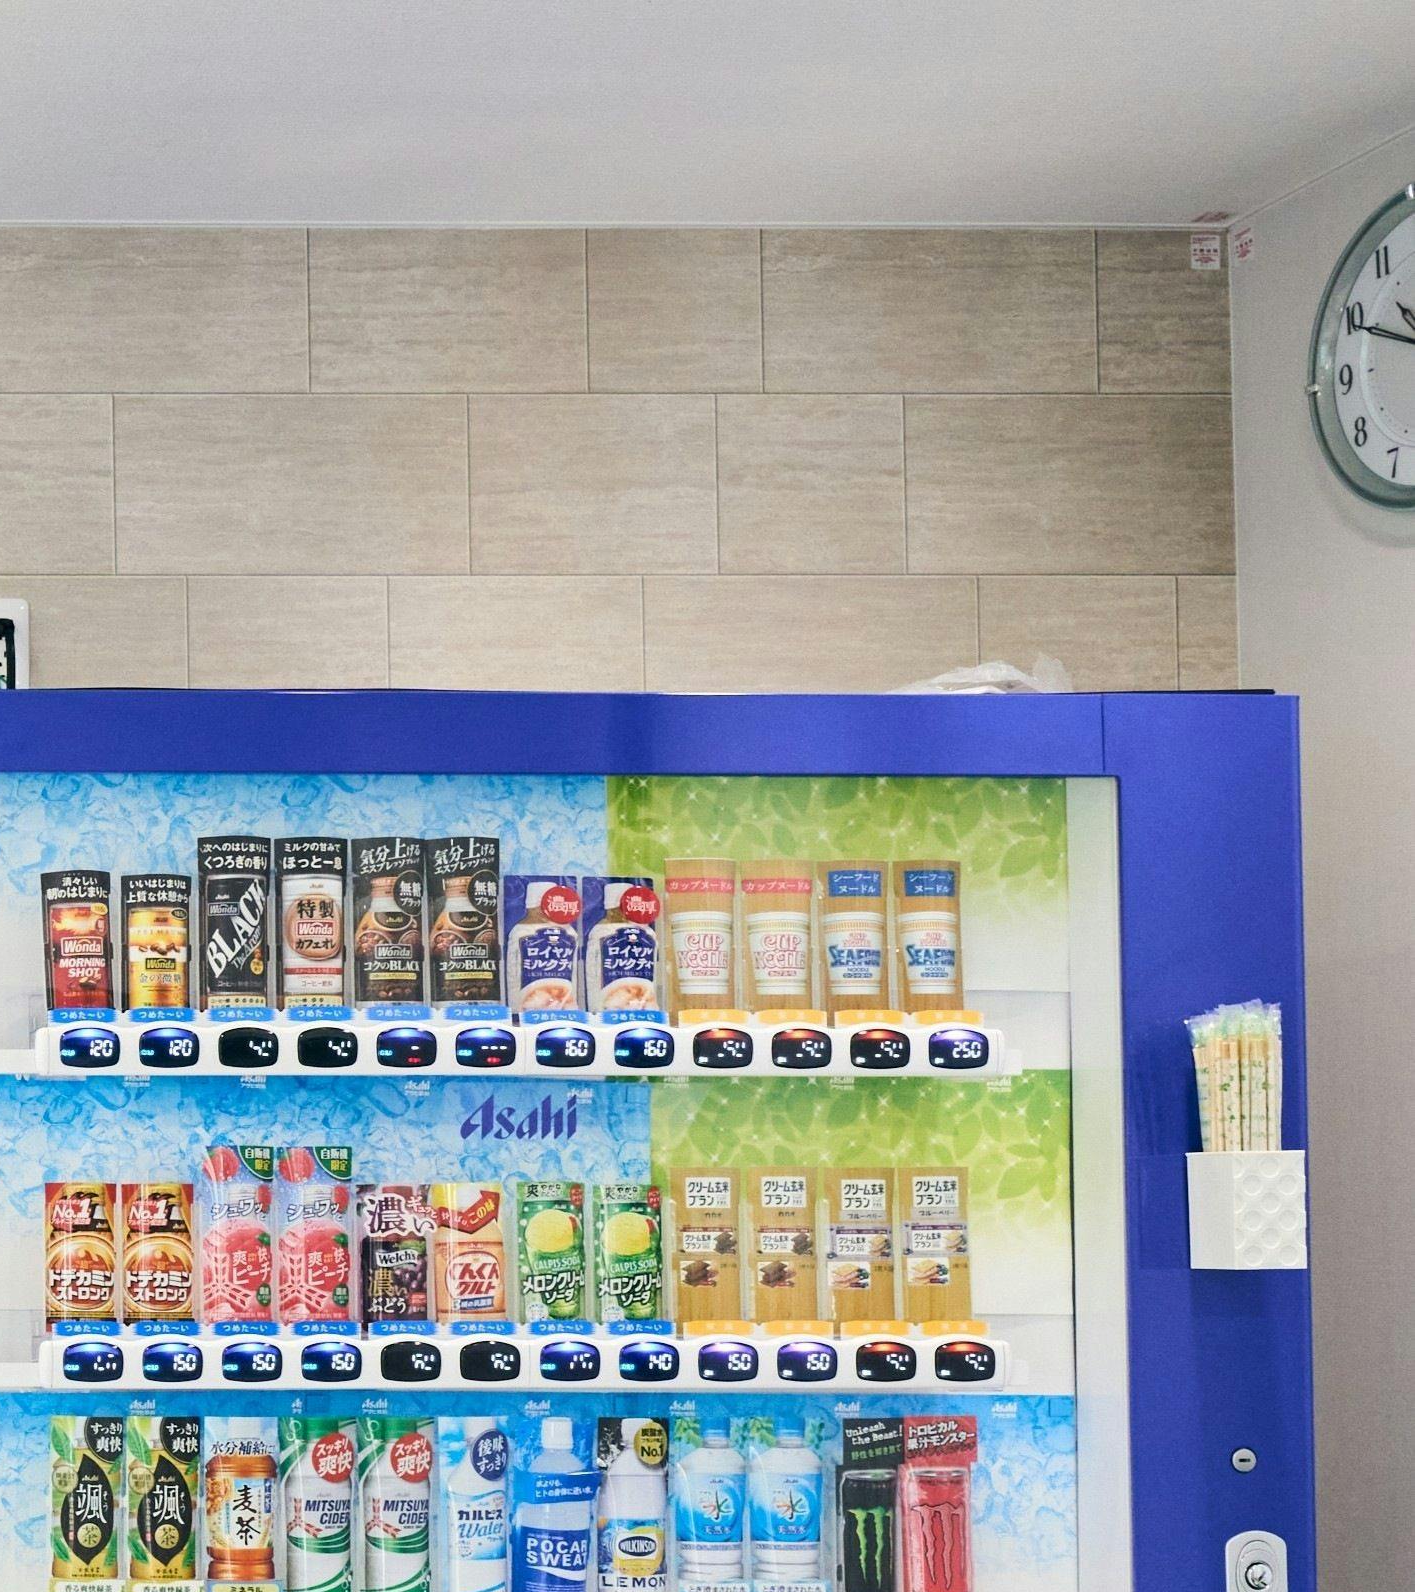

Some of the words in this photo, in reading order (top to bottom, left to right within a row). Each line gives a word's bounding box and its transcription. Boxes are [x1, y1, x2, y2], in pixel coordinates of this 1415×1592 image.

[1376, 246, 1389, 278] 11
[1347, 302, 1363, 334] 10
[1340, 365, 1352, 394] 9
[1354, 417, 1367, 447] 8
[1387, 447, 1399, 478] 7
[209, 904, 238, 914] Wonda
[296, 899, 334, 918] 特製
[298, 921, 333, 936] Wonda
[64, 938, 101, 954] Wonda
[59, 958, 105, 968] MORNING
[146, 959, 175, 969] Wonda
[68, 967, 100, 978] SHOT
[952, 1042, 981, 1058] 250
[460, 1094, 577, 1140] Asahi
[687, 1180, 730, 1194] クリーム玄米
[764, 1180, 804, 1193] クリーム玄米
[688, 1195, 715, 1205] ブラン
[764, 1194, 791, 1205] ブラン
[368, 1299, 406, 1314] ぶどう
[640, 1445, 664, 1458] No.1
[304, 1499, 351, 1511] MITSUYA
[383, 1499, 429, 1511] MITSUYA
[233, 1485, 260, 1545] 麦茶
[320, 1512, 350, 1525] CIDER
[398, 1512, 429, 1525] CIDER
[457, 1509, 503, 1521] カルピス
[618, 1539, 656, 1554] WILKINSON
[601, 1575, 667, 1588] LEMON
